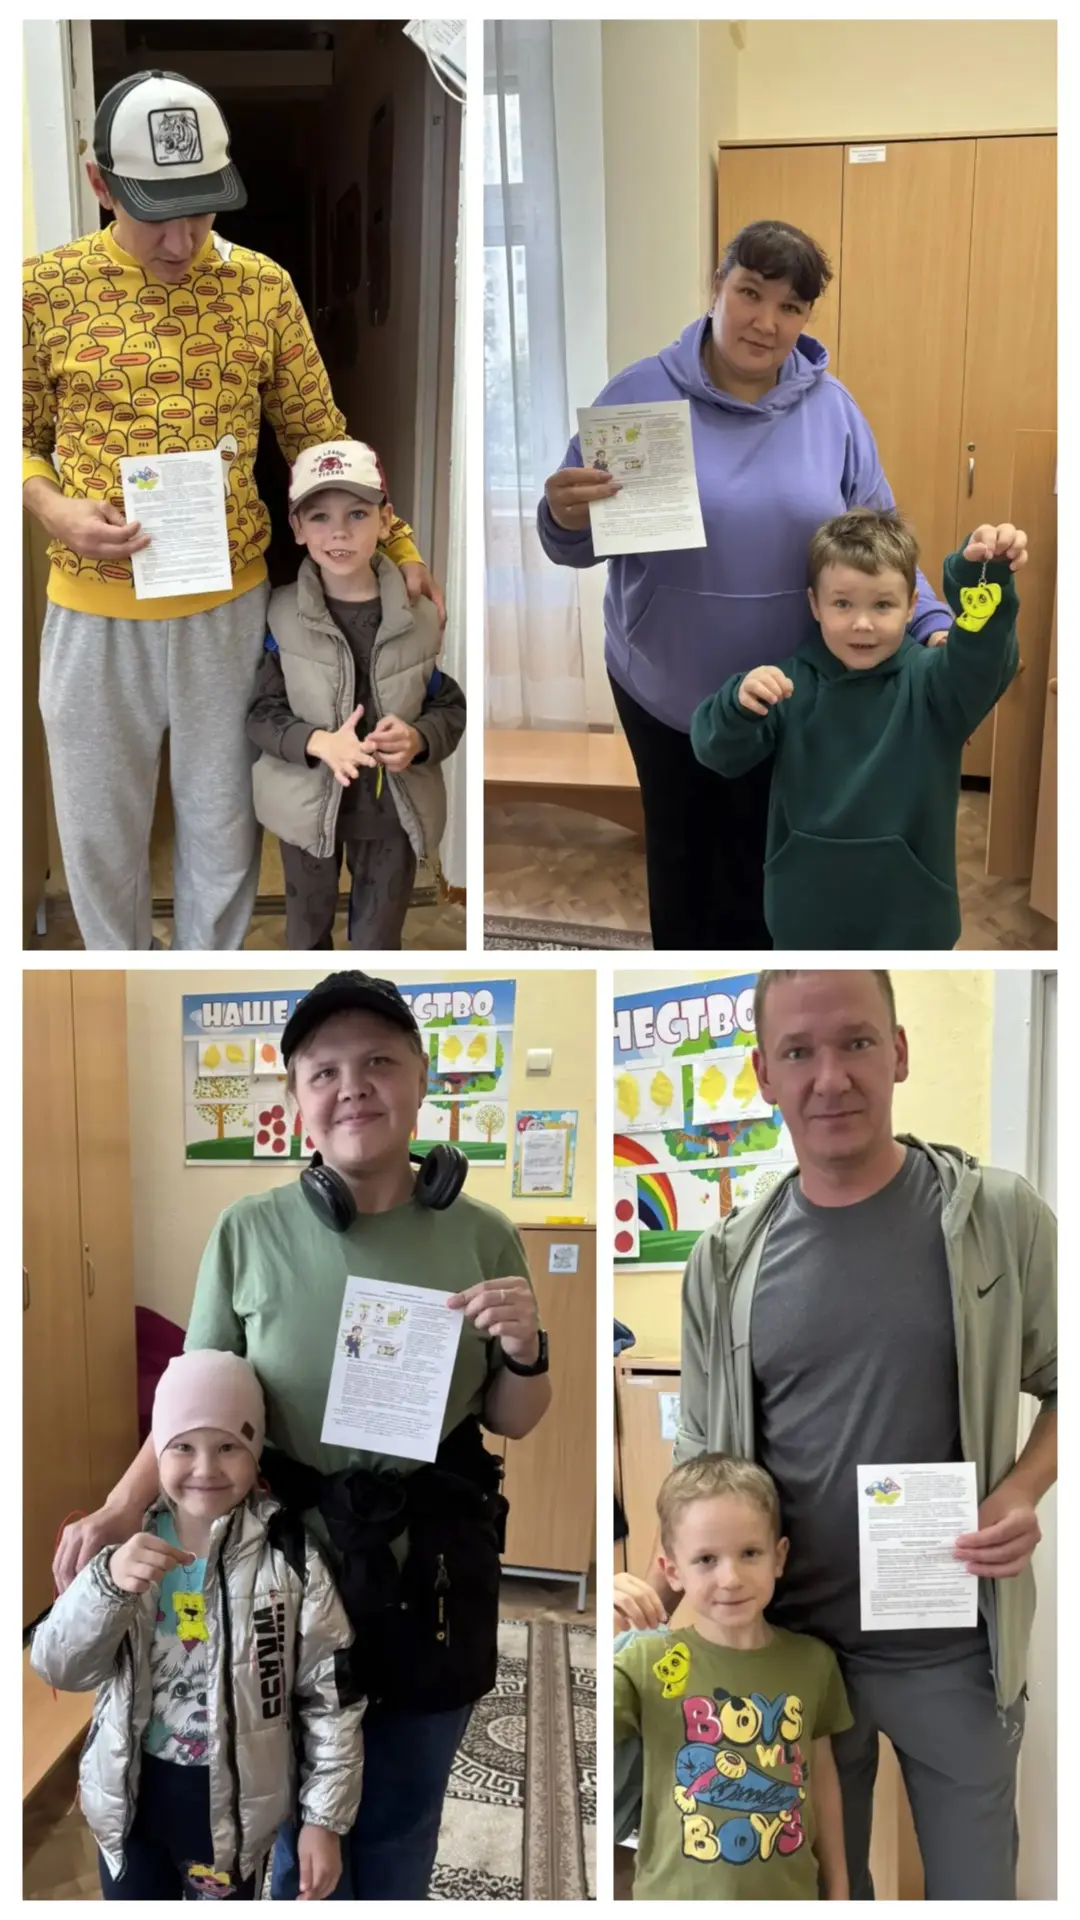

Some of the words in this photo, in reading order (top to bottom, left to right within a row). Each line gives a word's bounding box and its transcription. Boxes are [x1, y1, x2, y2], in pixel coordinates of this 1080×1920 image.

[201, 999, 288, 1028] НАШЕ
[681, 1690, 804, 1746] BOYS
[681, 1811, 806, 1866] BOYS
